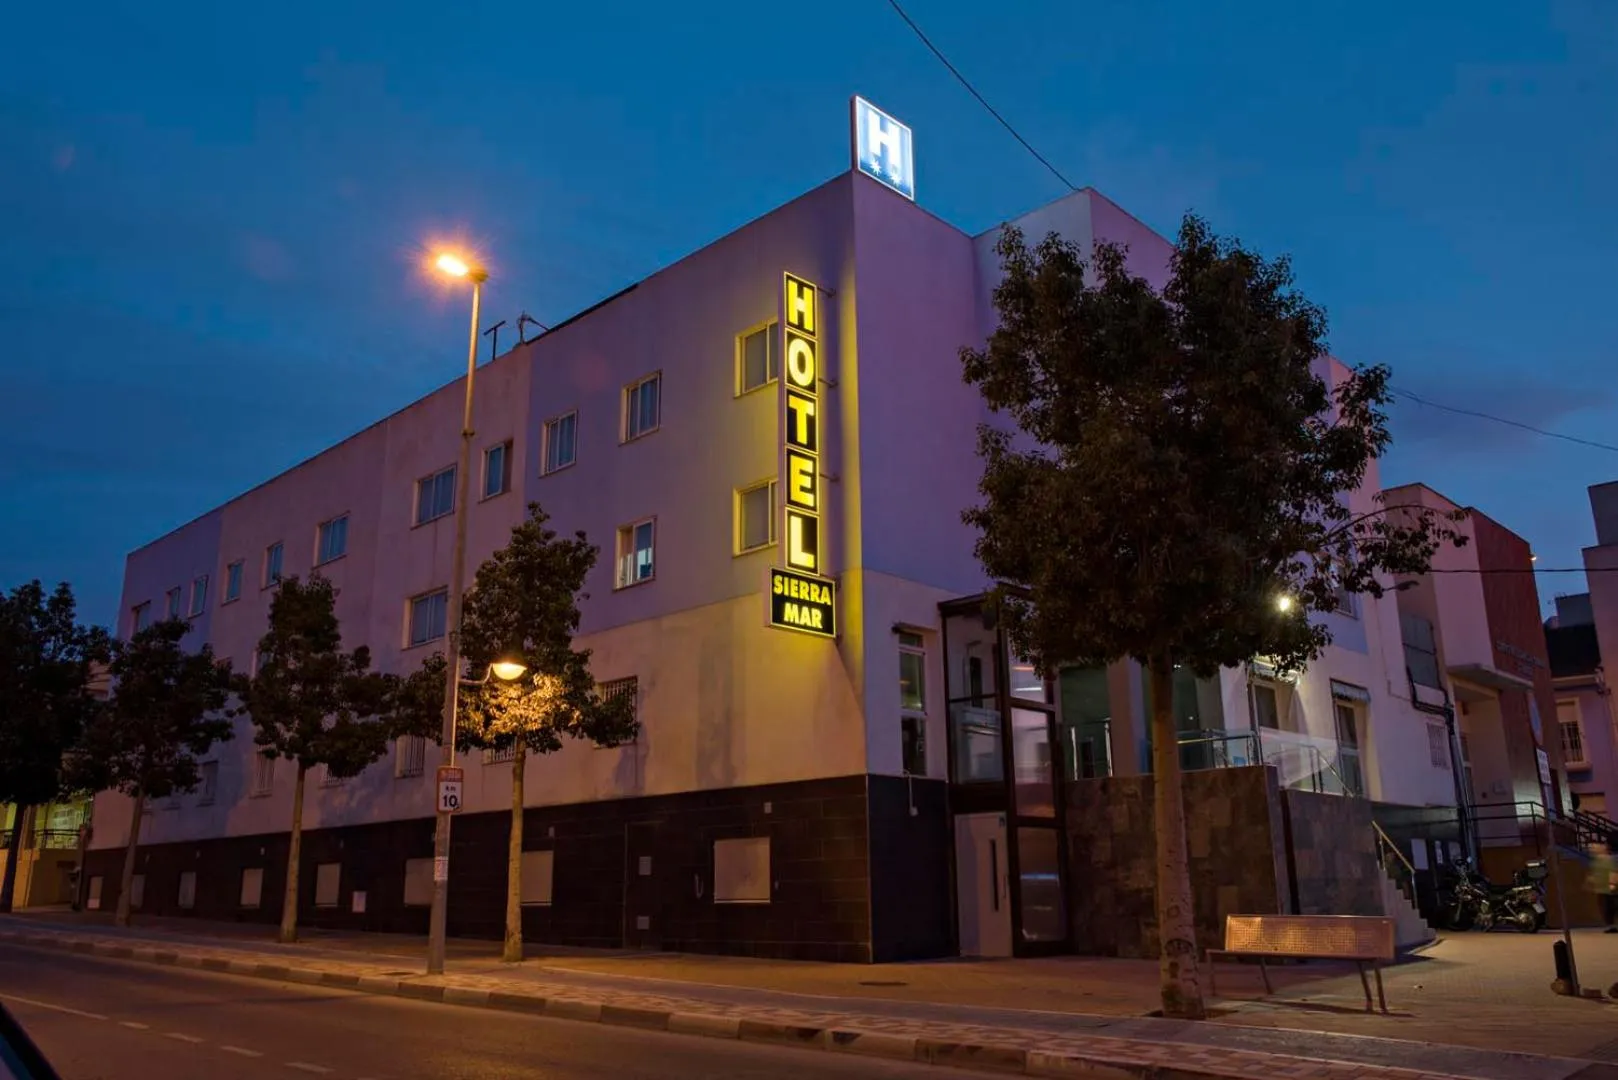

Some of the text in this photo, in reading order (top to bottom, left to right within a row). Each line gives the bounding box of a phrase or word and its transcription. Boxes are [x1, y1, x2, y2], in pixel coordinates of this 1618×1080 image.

[867, 108, 901, 168] H
[787, 280, 815, 569] HOTEL
[773, 575, 831, 605] SIERRA
[783, 602, 823, 629] MAR
[443, 794, 458, 808] 10
